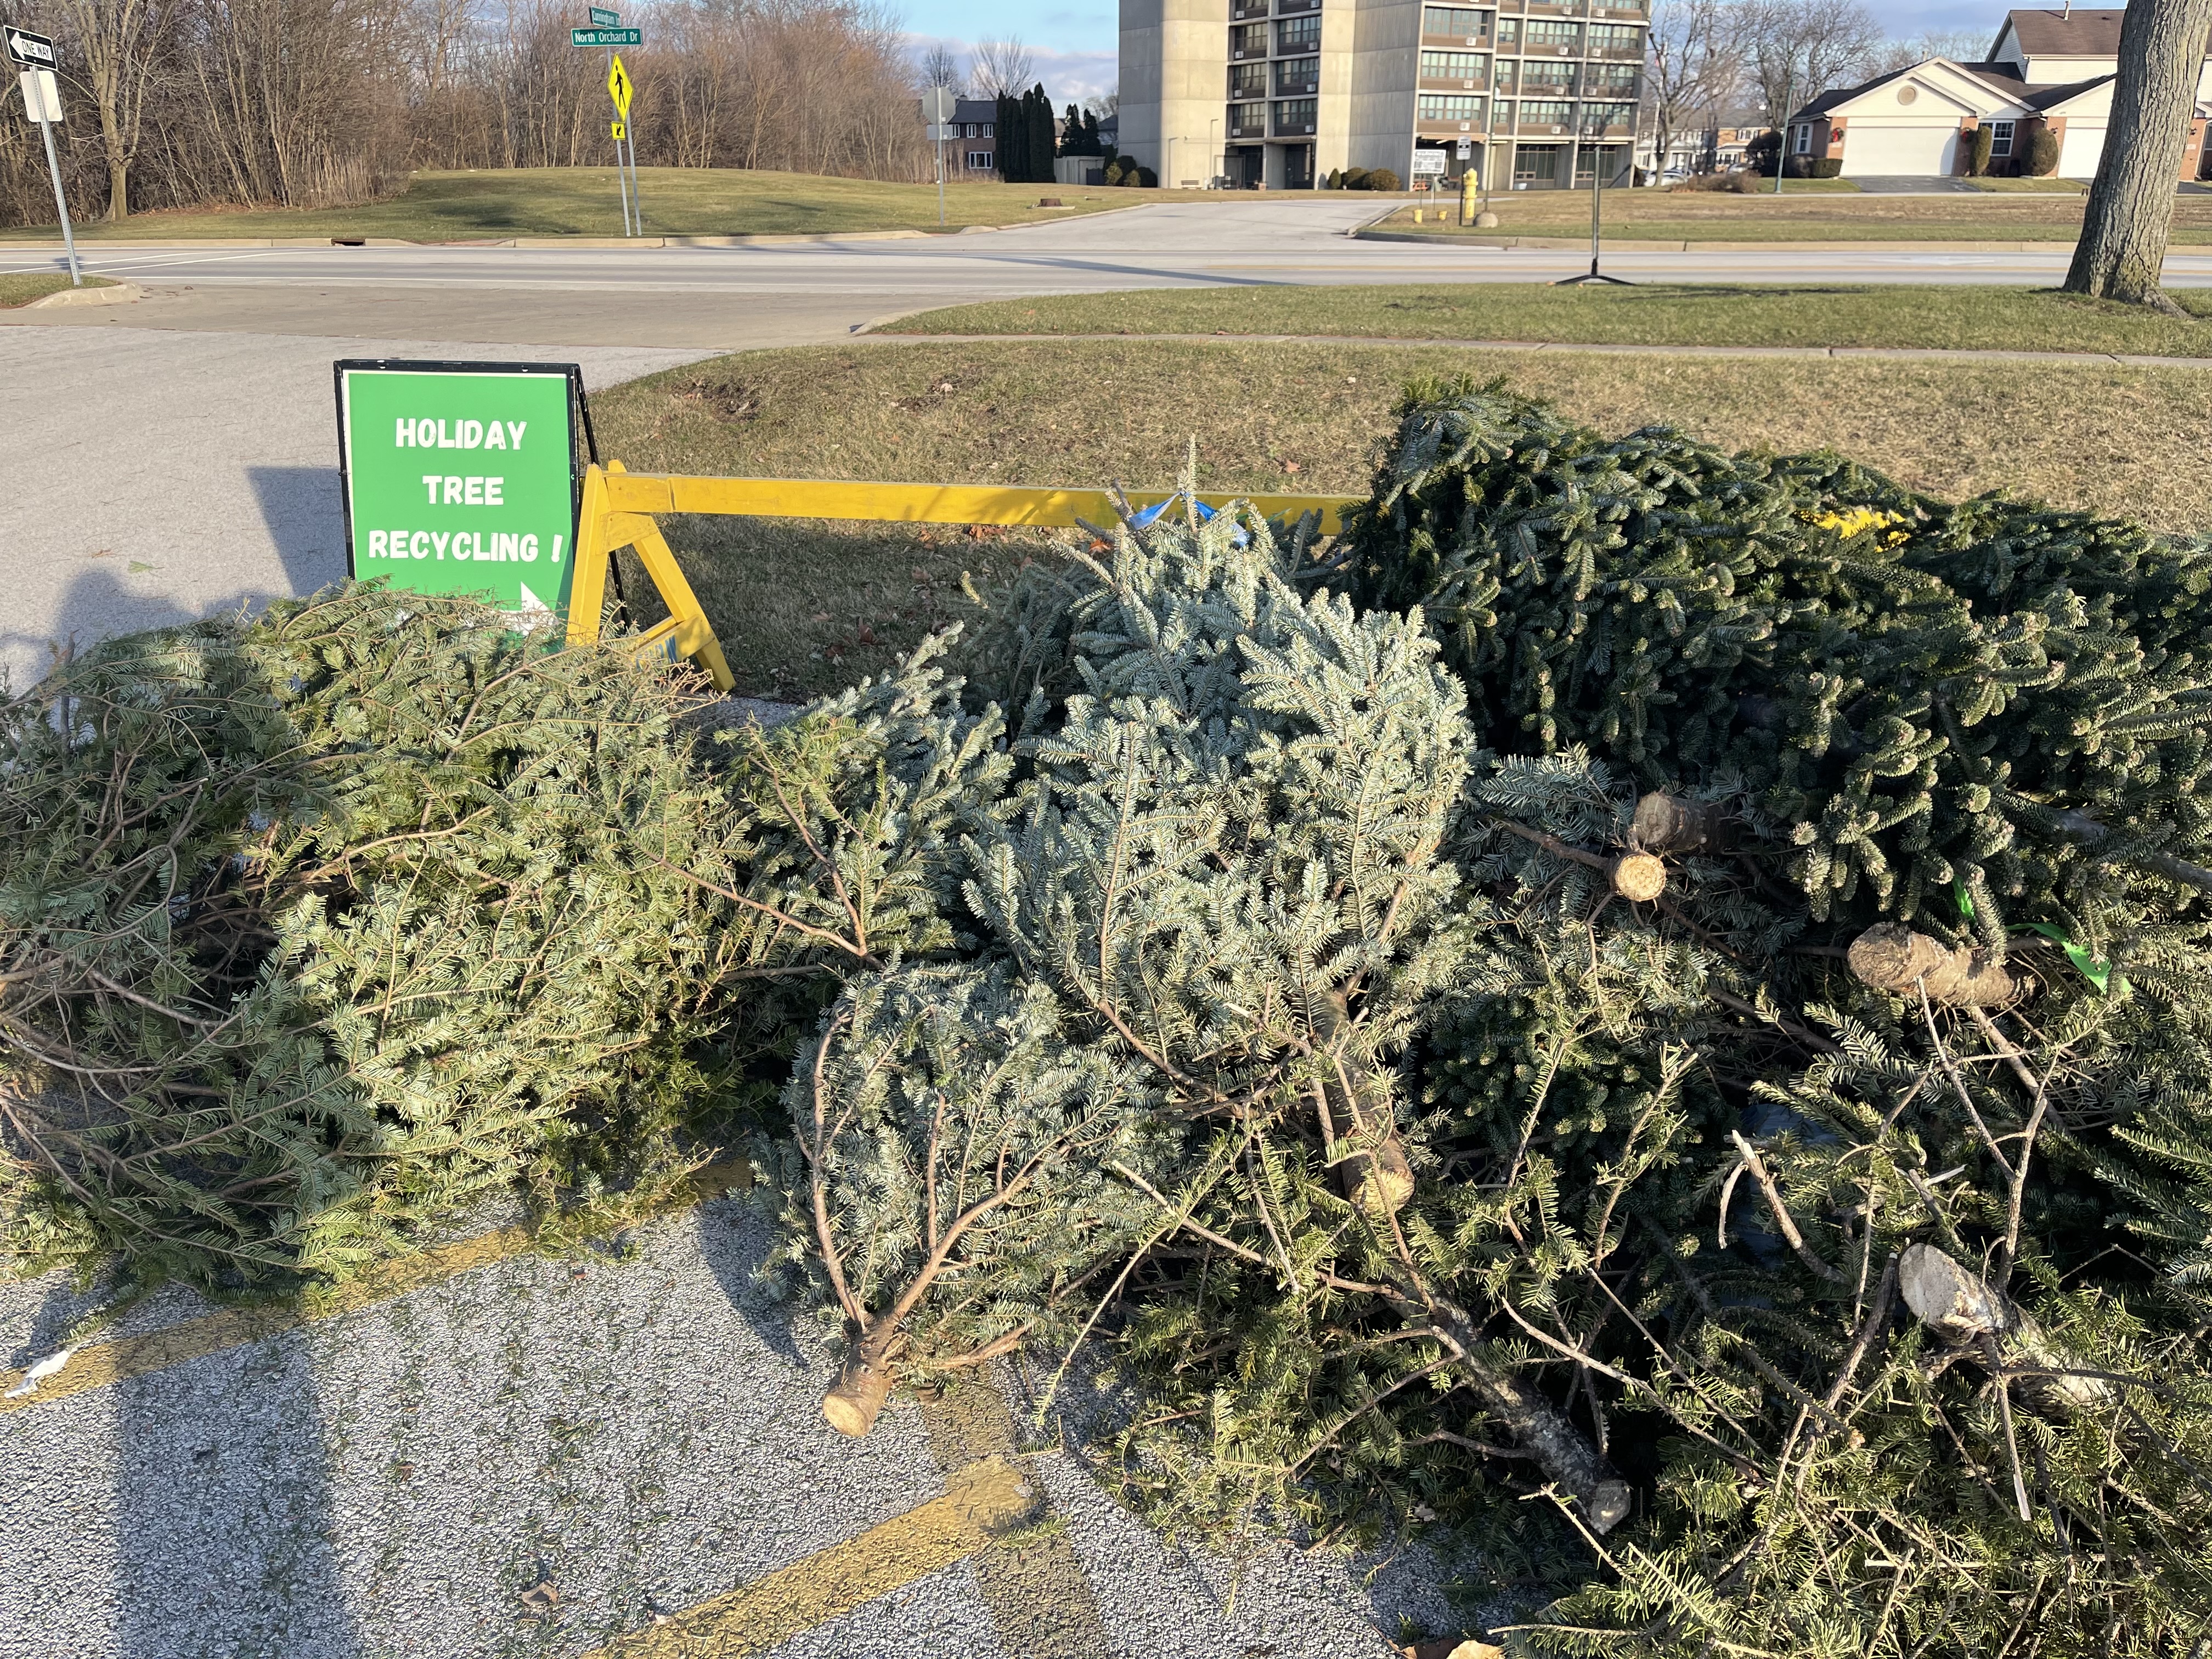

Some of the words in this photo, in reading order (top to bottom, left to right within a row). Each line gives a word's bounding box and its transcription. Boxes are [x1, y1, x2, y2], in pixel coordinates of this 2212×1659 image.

[592, 10, 615, 25] Cunningham
[575, 32, 595, 42] North
[599, 31, 627, 42] Orchard
[630, 31, 637, 42] Dr
[22, 41, 36, 55] ONE
[36, 44, 49, 58] WAY
[396, 418, 527, 449] HOLIDAY
[422, 475, 504, 505] TREE
[369, 530, 538, 562] RECYCLING
